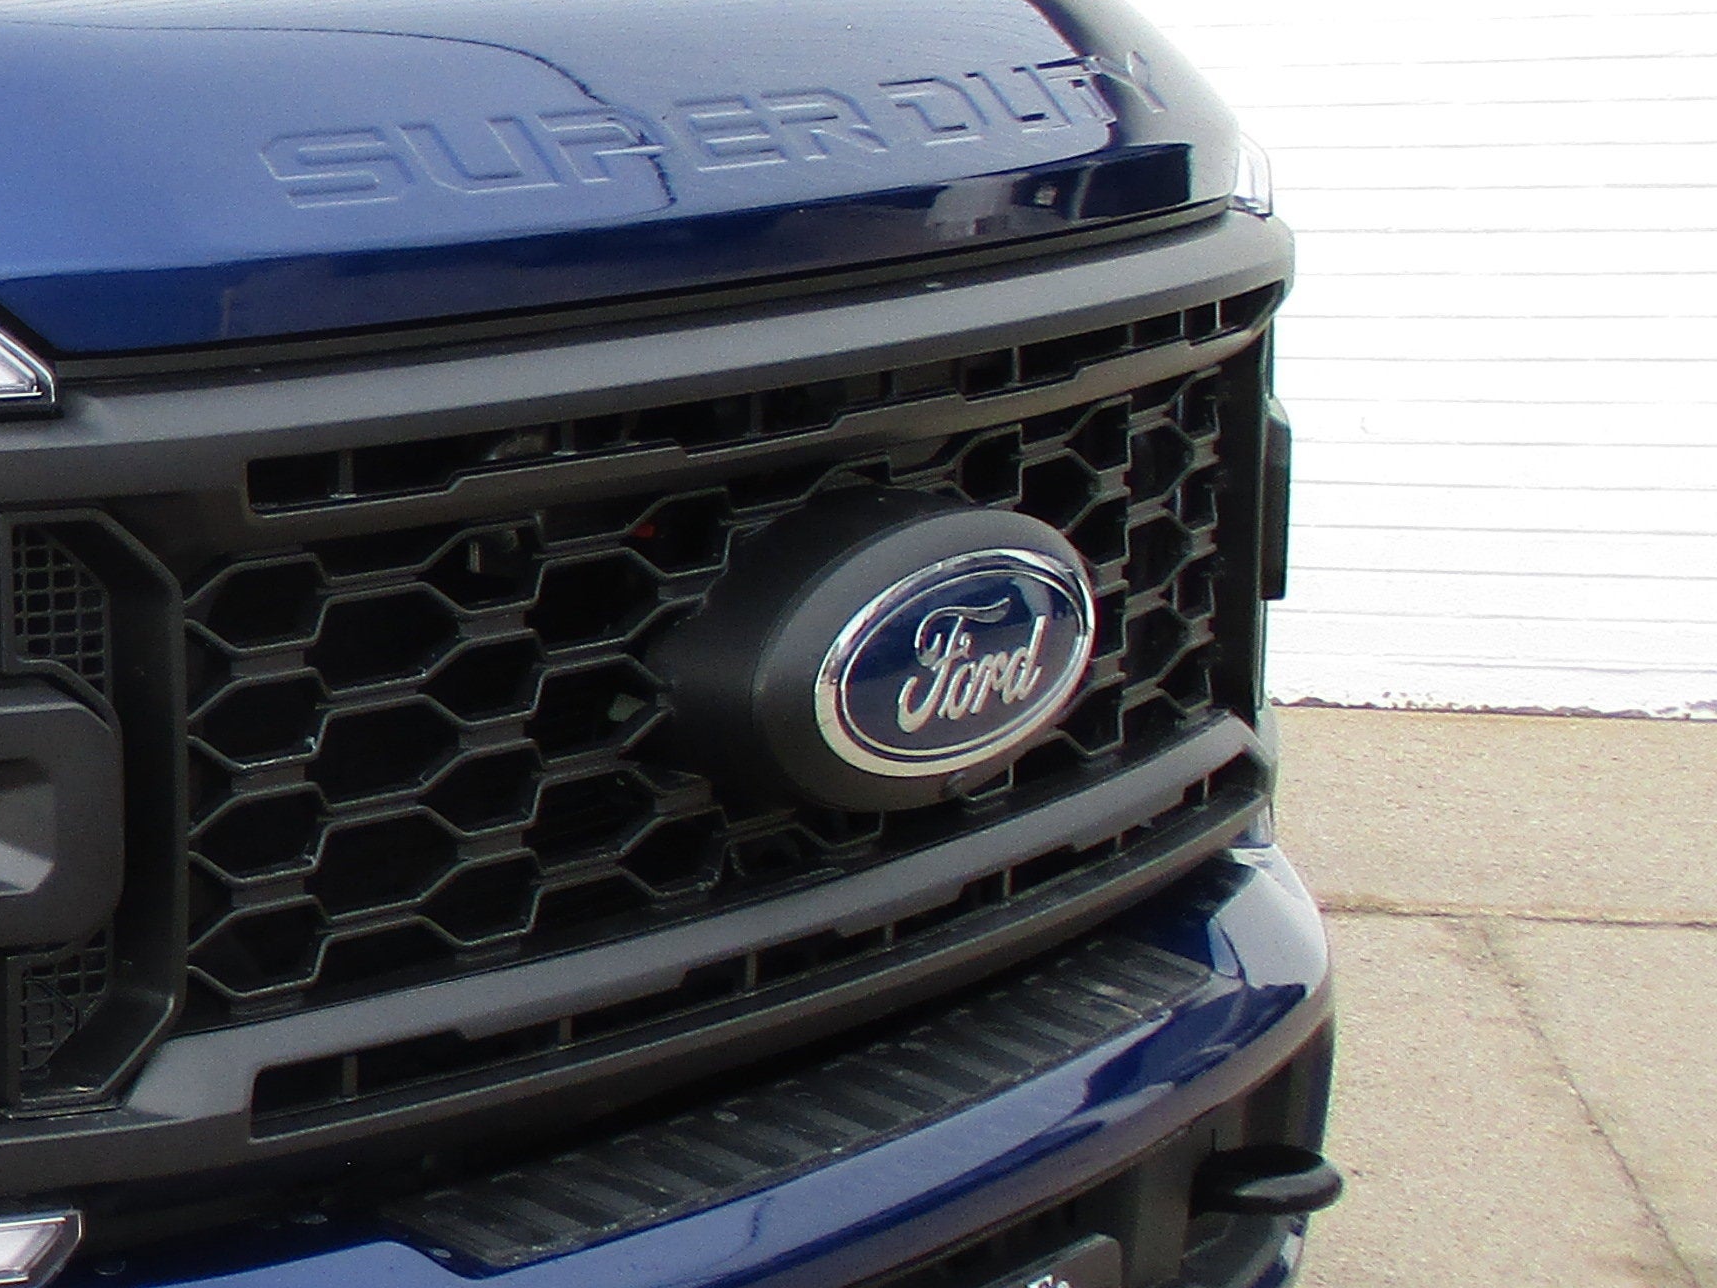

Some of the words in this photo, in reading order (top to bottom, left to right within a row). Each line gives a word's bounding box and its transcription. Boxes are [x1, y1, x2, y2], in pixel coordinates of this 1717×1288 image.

[259, 88, 888, 209] SUPER
[876, 50, 1167, 146] DUTY
[897, 597, 1048, 734] Ford
